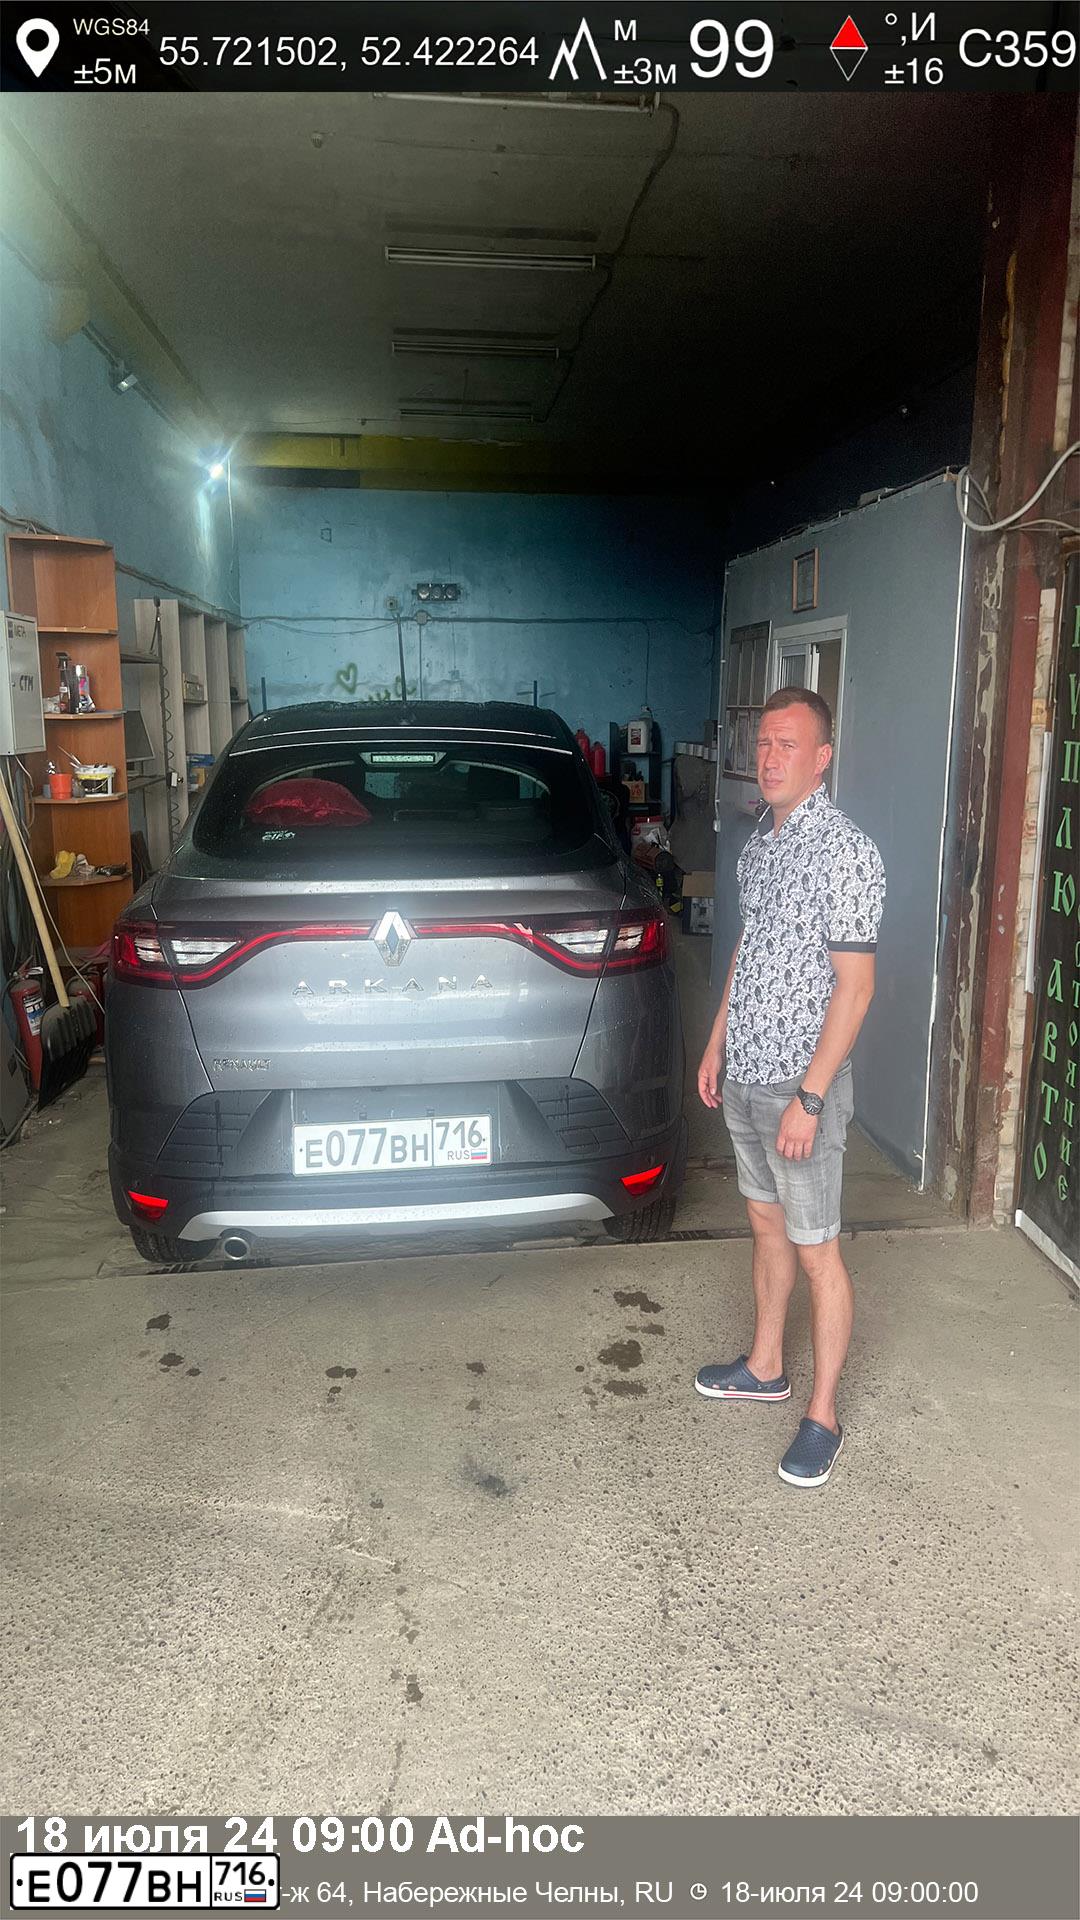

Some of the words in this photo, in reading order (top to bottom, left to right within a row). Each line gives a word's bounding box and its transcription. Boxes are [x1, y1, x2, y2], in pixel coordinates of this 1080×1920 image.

[292, 974, 493, 996] ARKANA
[1034, 958, 1064, 1181] АВТО
[305, 1127, 429, 1169] Е077ВН
[435, 1119, 483, 1151] 716
[447, 1149, 470, 1161] RUS
